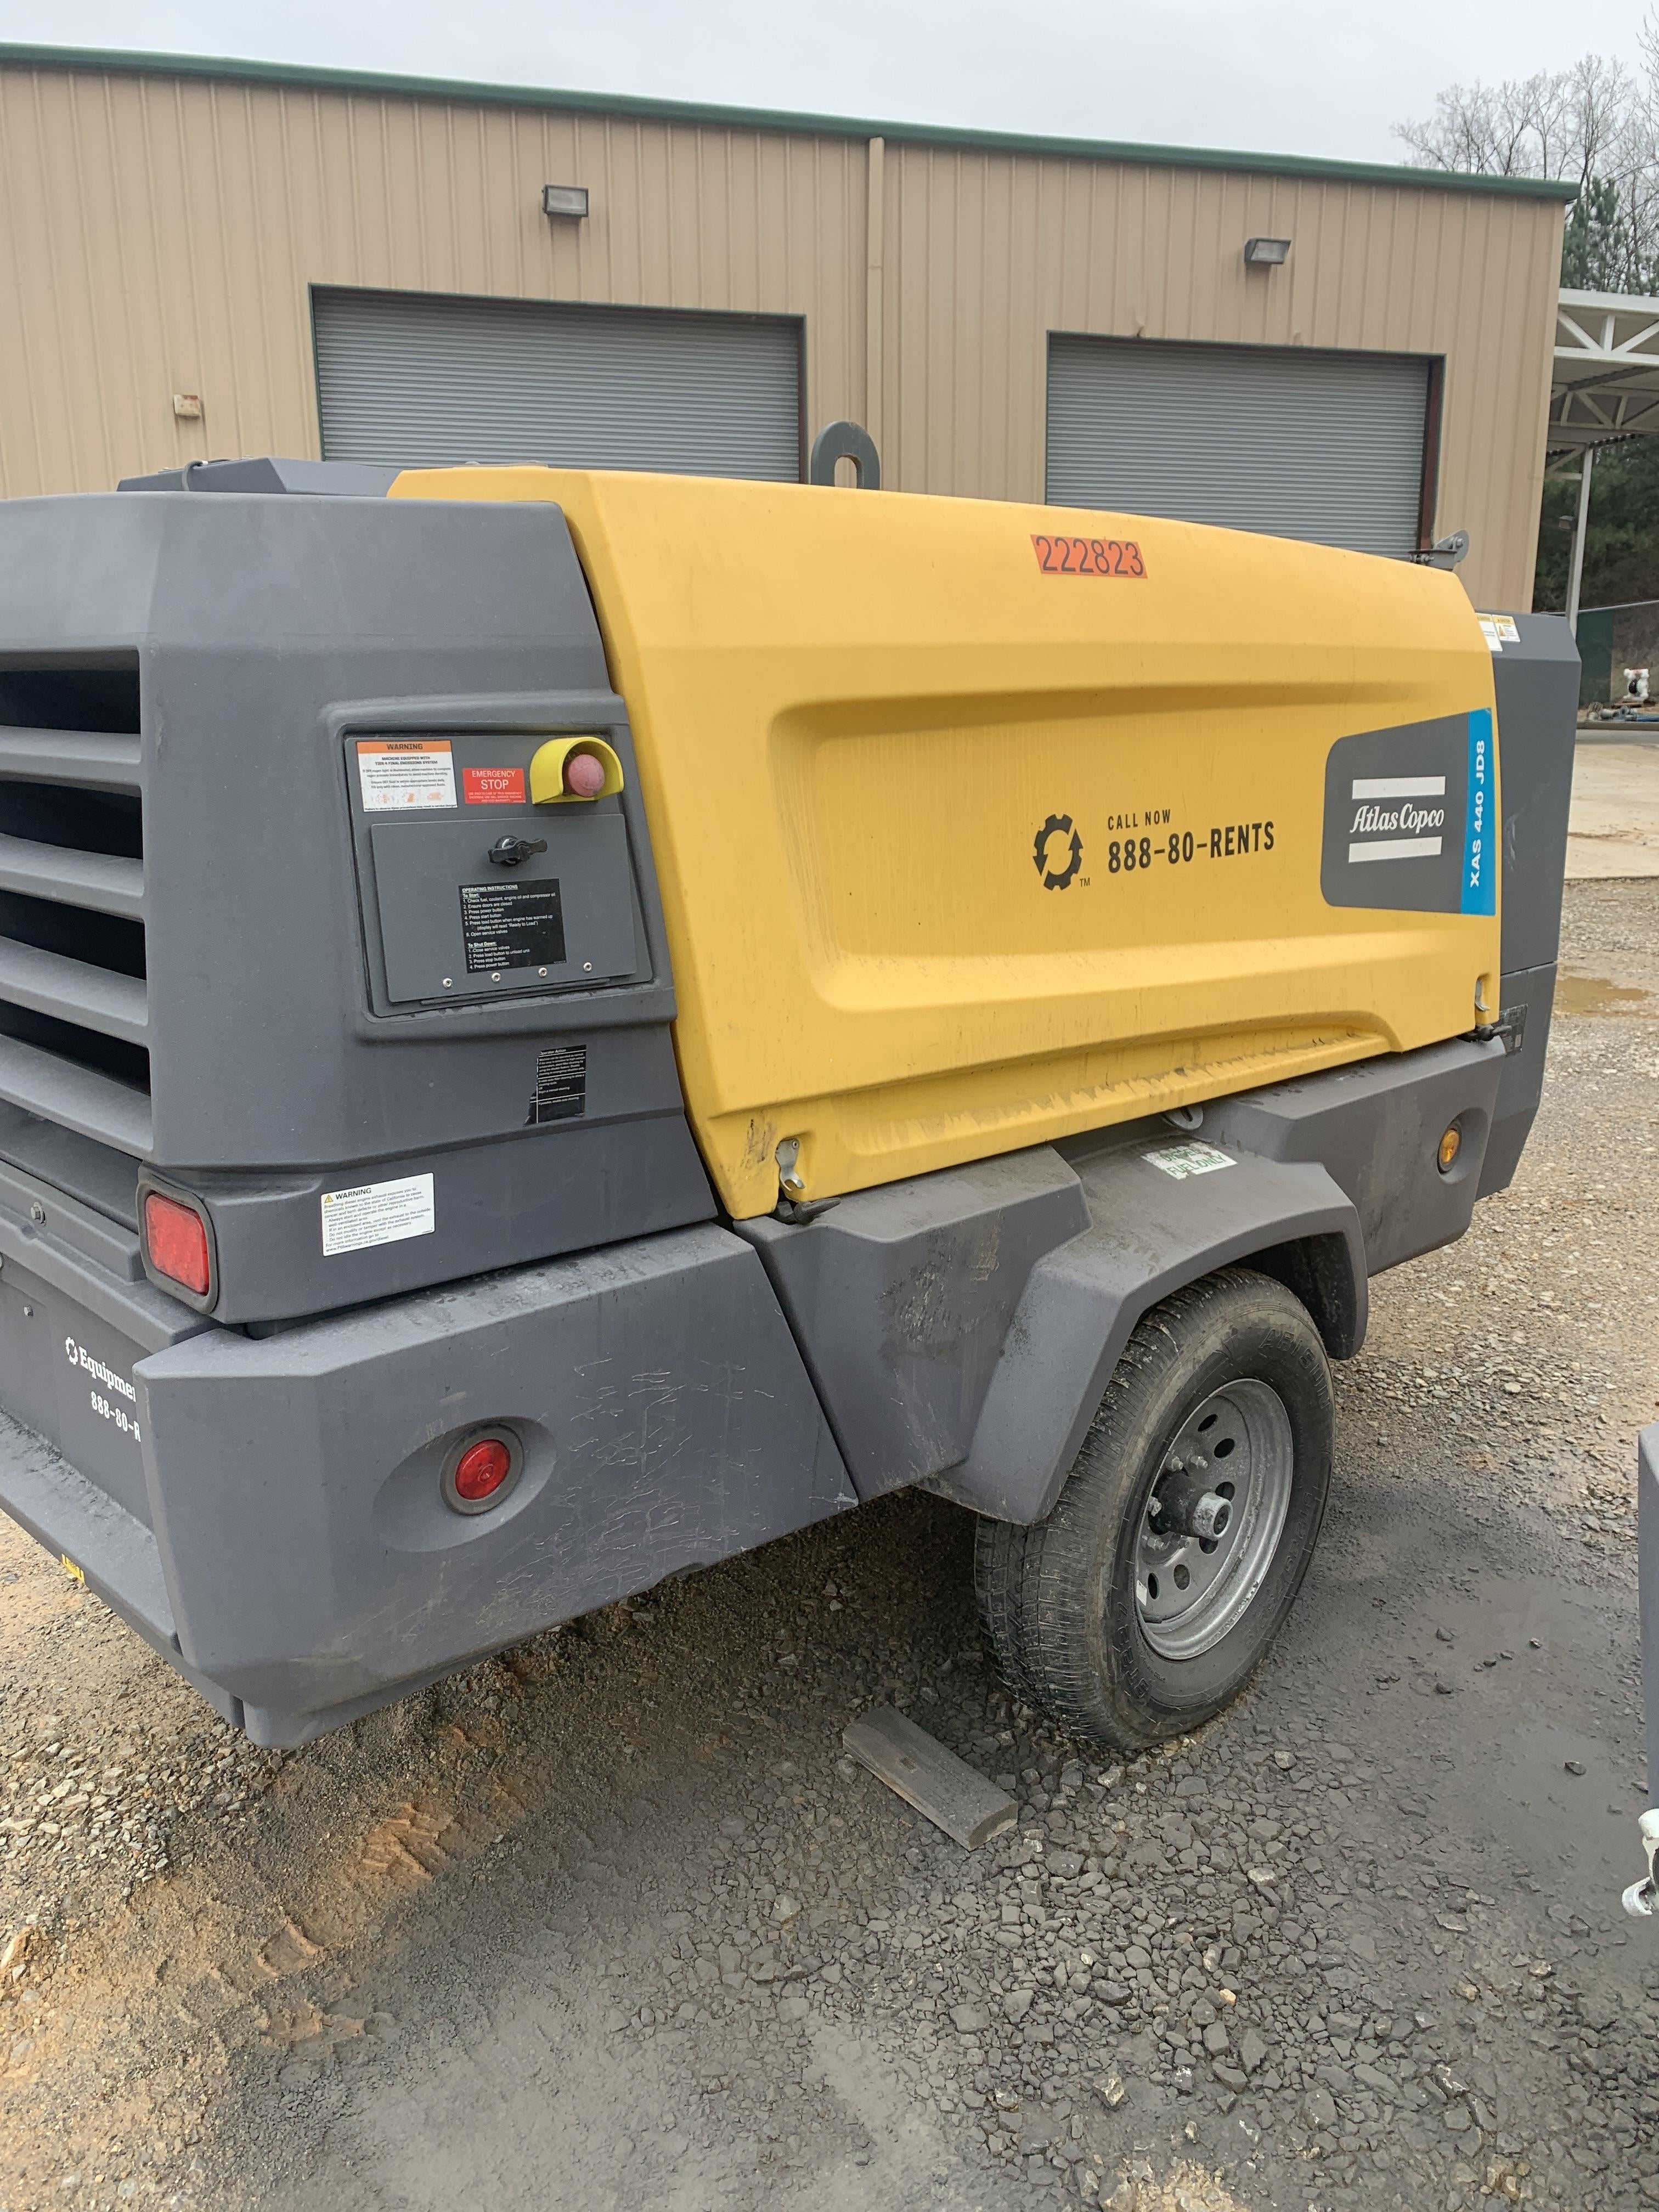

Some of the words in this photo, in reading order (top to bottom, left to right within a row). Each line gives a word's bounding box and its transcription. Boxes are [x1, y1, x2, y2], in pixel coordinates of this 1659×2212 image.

[1036, 535, 1143, 575] 222823
[1476, 740, 1485, 785] JD8
[481, 779, 509, 790] STOP
[1108, 814, 1138, 830] CALL
[1145, 809, 1171, 825] NOW
[1350, 805, 1398, 833] Atlas
[1400, 803, 1444, 833] Copco
[1474, 791, 1483, 832] 440
[1108, 821, 1274, 873] 888-80-RENTS
[1470, 839, 1482, 888] XAS
[1080, 878, 1090, 887] TM
[1166, 1162, 1200, 1176] FUEL
[1195, 1154, 1227, 1168] ONLY
[335, 1188, 371, 1200] WARNING
